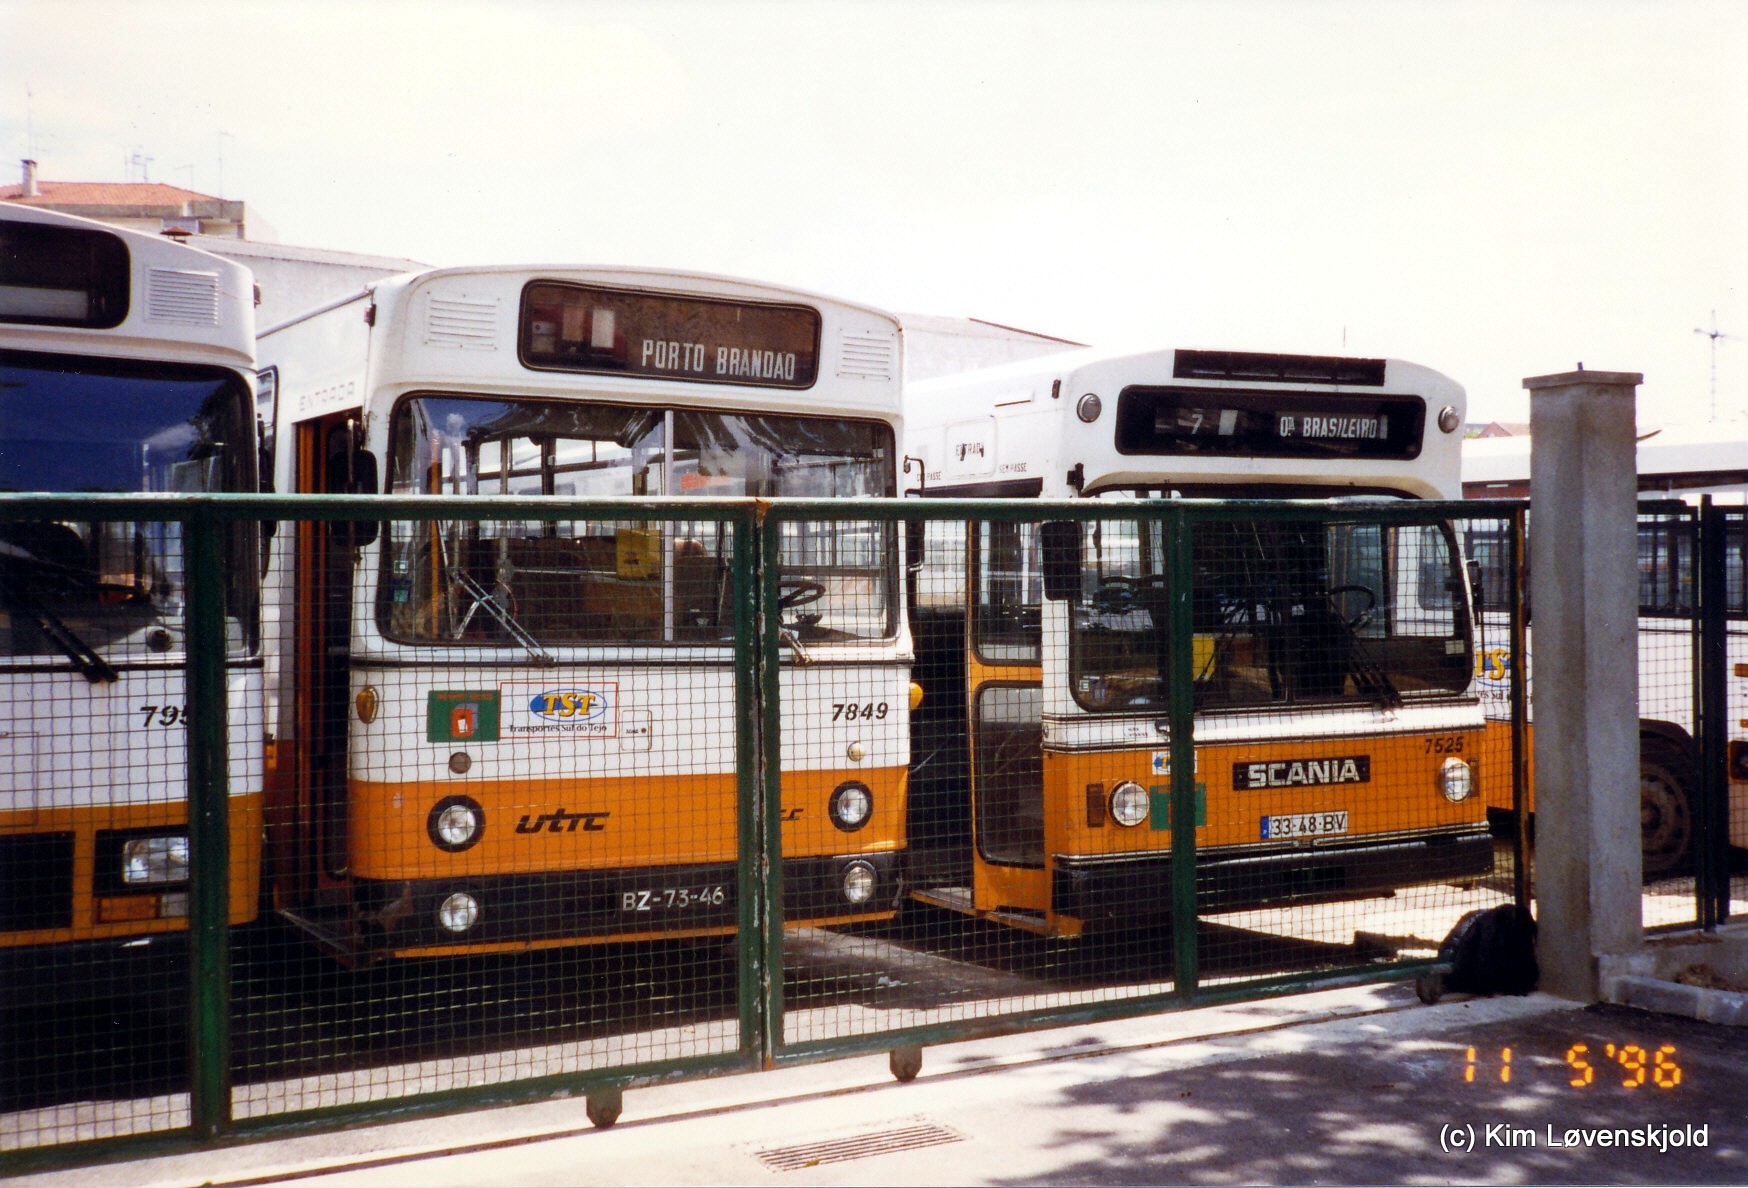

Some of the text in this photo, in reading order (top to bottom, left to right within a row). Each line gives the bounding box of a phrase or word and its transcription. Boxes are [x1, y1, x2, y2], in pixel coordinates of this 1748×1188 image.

[641, 339, 796, 381] PORTO BRANDAO
[1302, 417, 1378, 439] BRASILEIRO
[542, 692, 596, 717] TST
[831, 702, 888, 721] 7849
[1425, 736, 1464, 754] 7525
[1248, 759, 1360, 788] SCANIA
[622, 886, 724, 911] BZ-73-46
